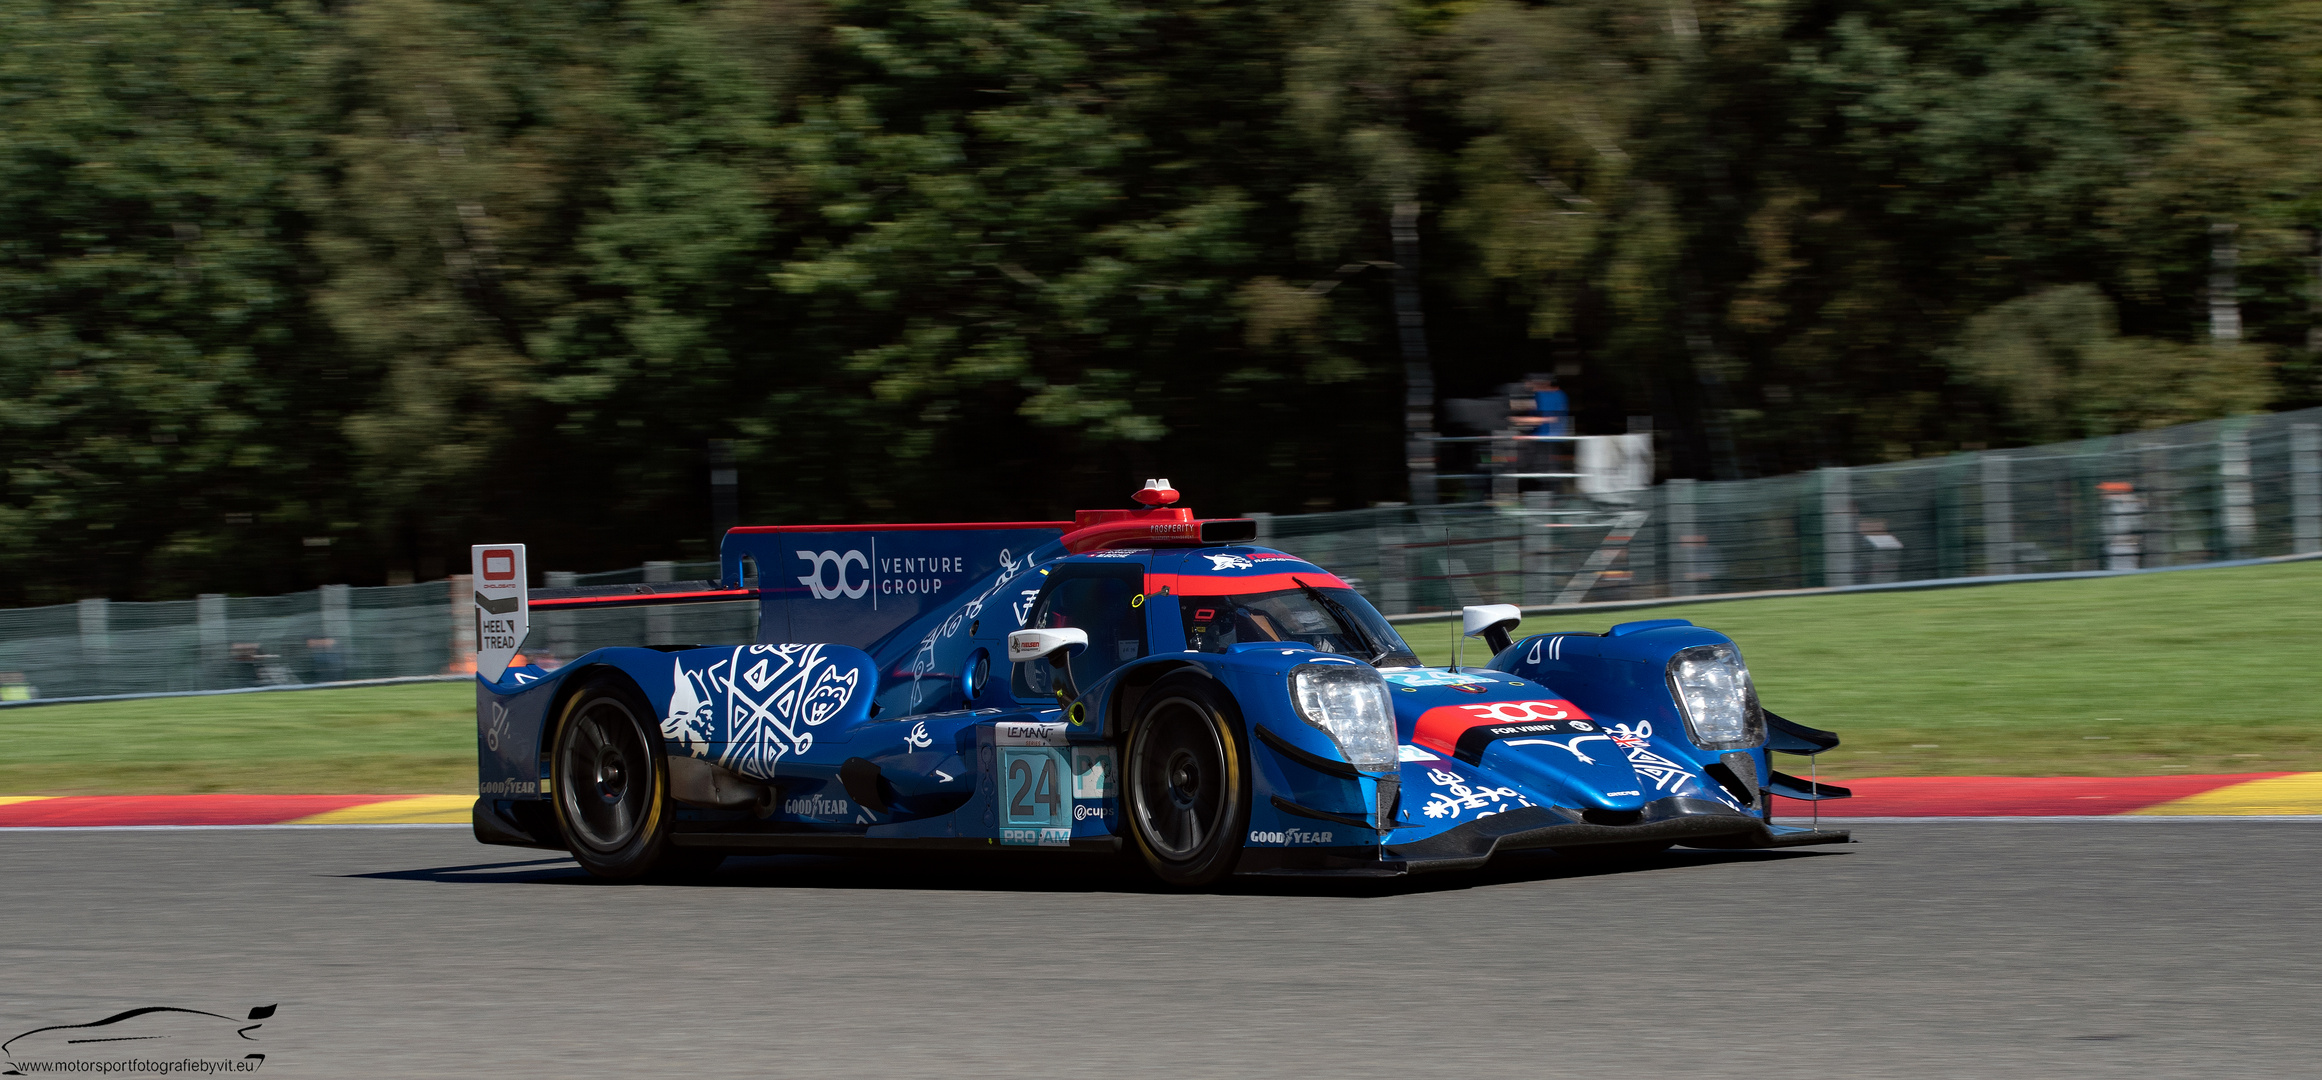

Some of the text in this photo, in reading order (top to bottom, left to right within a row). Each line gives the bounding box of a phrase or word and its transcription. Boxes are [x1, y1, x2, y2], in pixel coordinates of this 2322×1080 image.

[1150, 524, 1194, 533] PROSPERITY
[881, 557, 963, 573] VENTURE
[796, 550, 870, 600] ROC
[882, 578, 942, 595] GROUP
[483, 620, 506, 633] HEEL
[484, 636, 515, 649] TREAD
[1491, 724, 1557, 735] FOR VINNY
[1076, 755, 1114, 790] P2
[1009, 759, 1061, 816] 24
[1004, 830, 1069, 844] PRO AM
